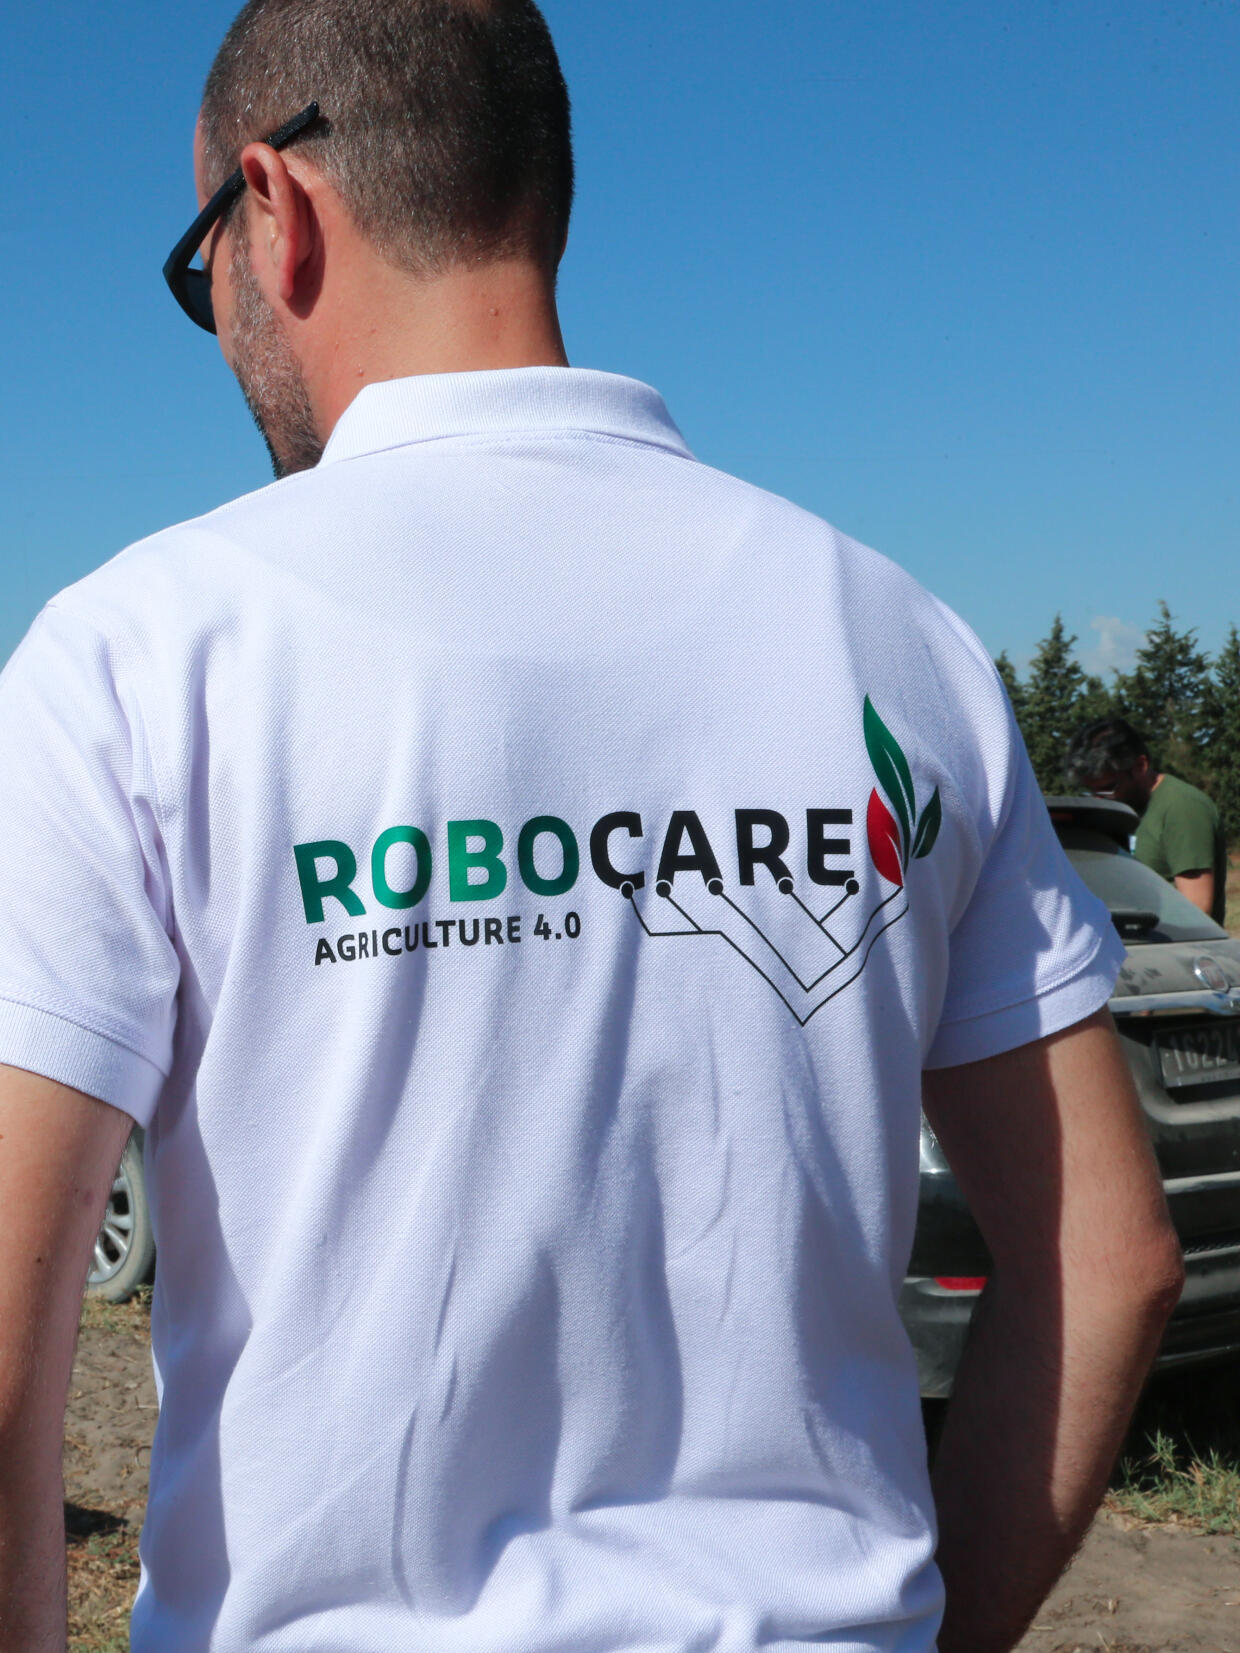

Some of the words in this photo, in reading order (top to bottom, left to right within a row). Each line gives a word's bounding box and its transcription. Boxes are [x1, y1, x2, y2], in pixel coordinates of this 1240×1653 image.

[293, 808, 855, 924] ROBOCARE
[314, 916, 521, 965] AGRICULTURE
[533, 911, 582, 940] 4.0
